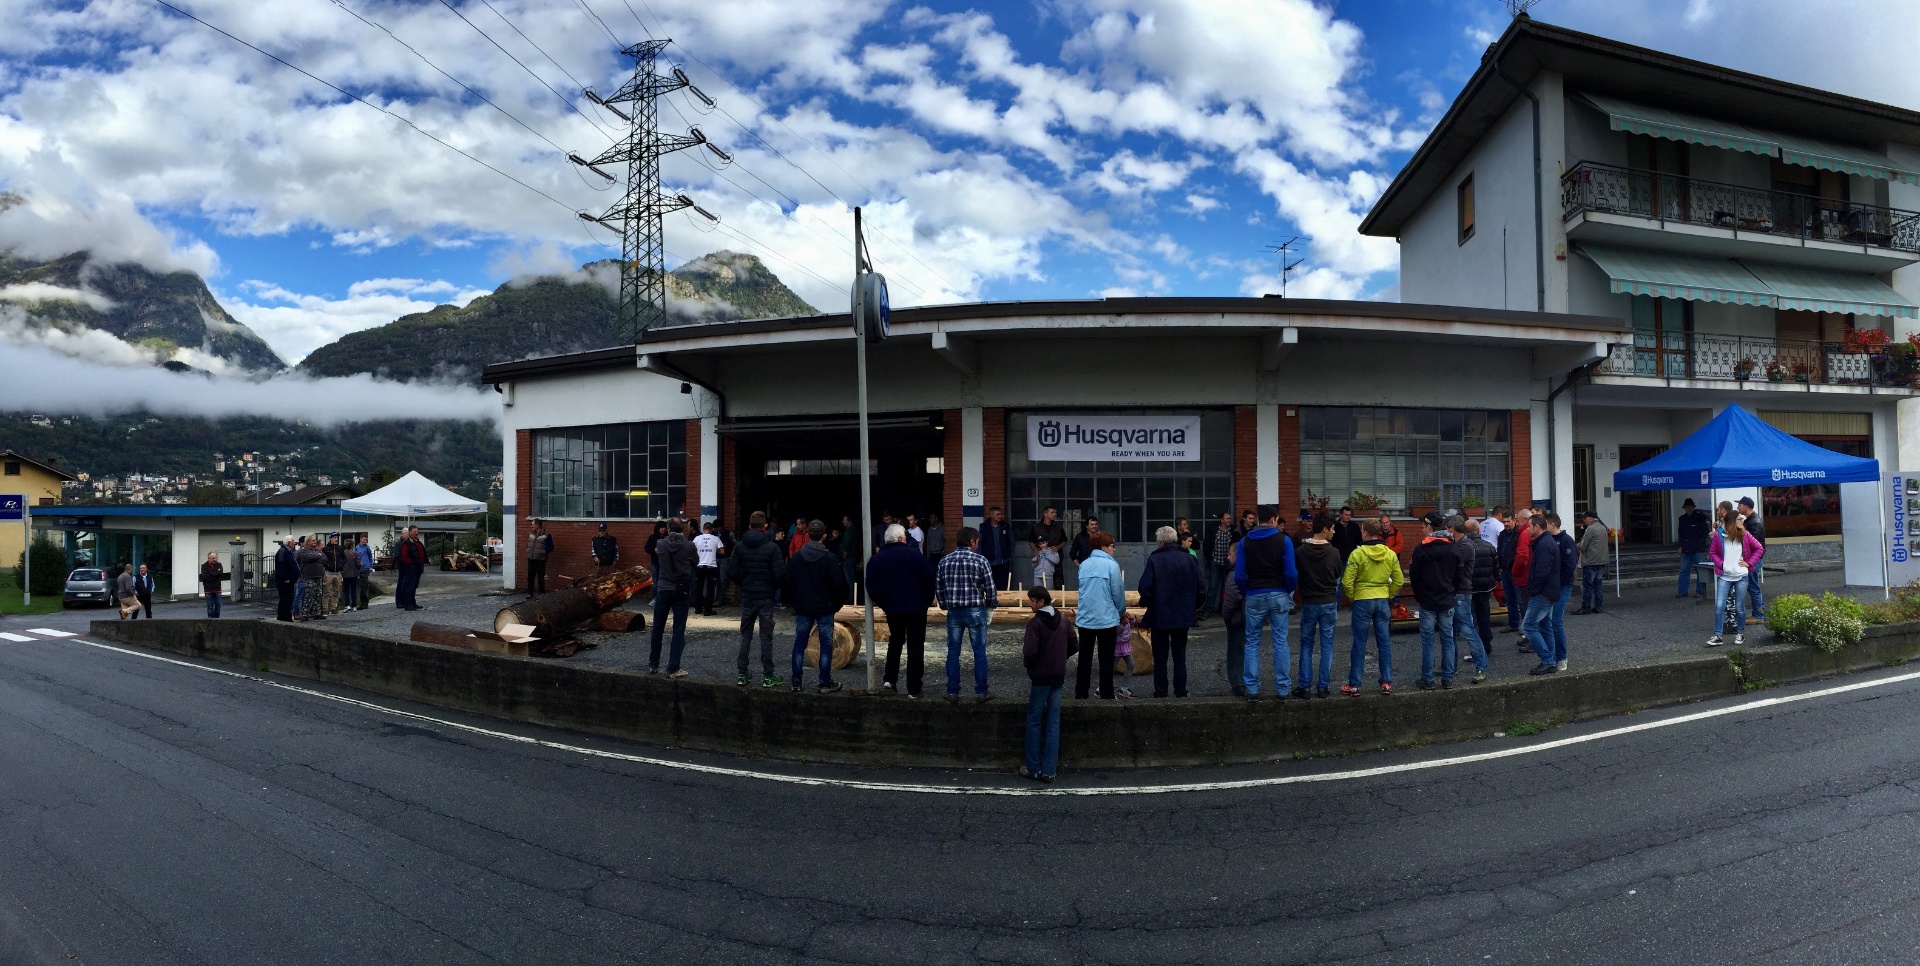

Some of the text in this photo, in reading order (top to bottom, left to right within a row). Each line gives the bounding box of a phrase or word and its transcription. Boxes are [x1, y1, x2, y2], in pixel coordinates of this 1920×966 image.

[1064, 424, 1186, 448] Husqvarna
[1647, 475, 1674, 485] Husqvarna
[1781, 469, 1826, 480] Husqvarna
[1892, 476, 1905, 547] Husqvarna
